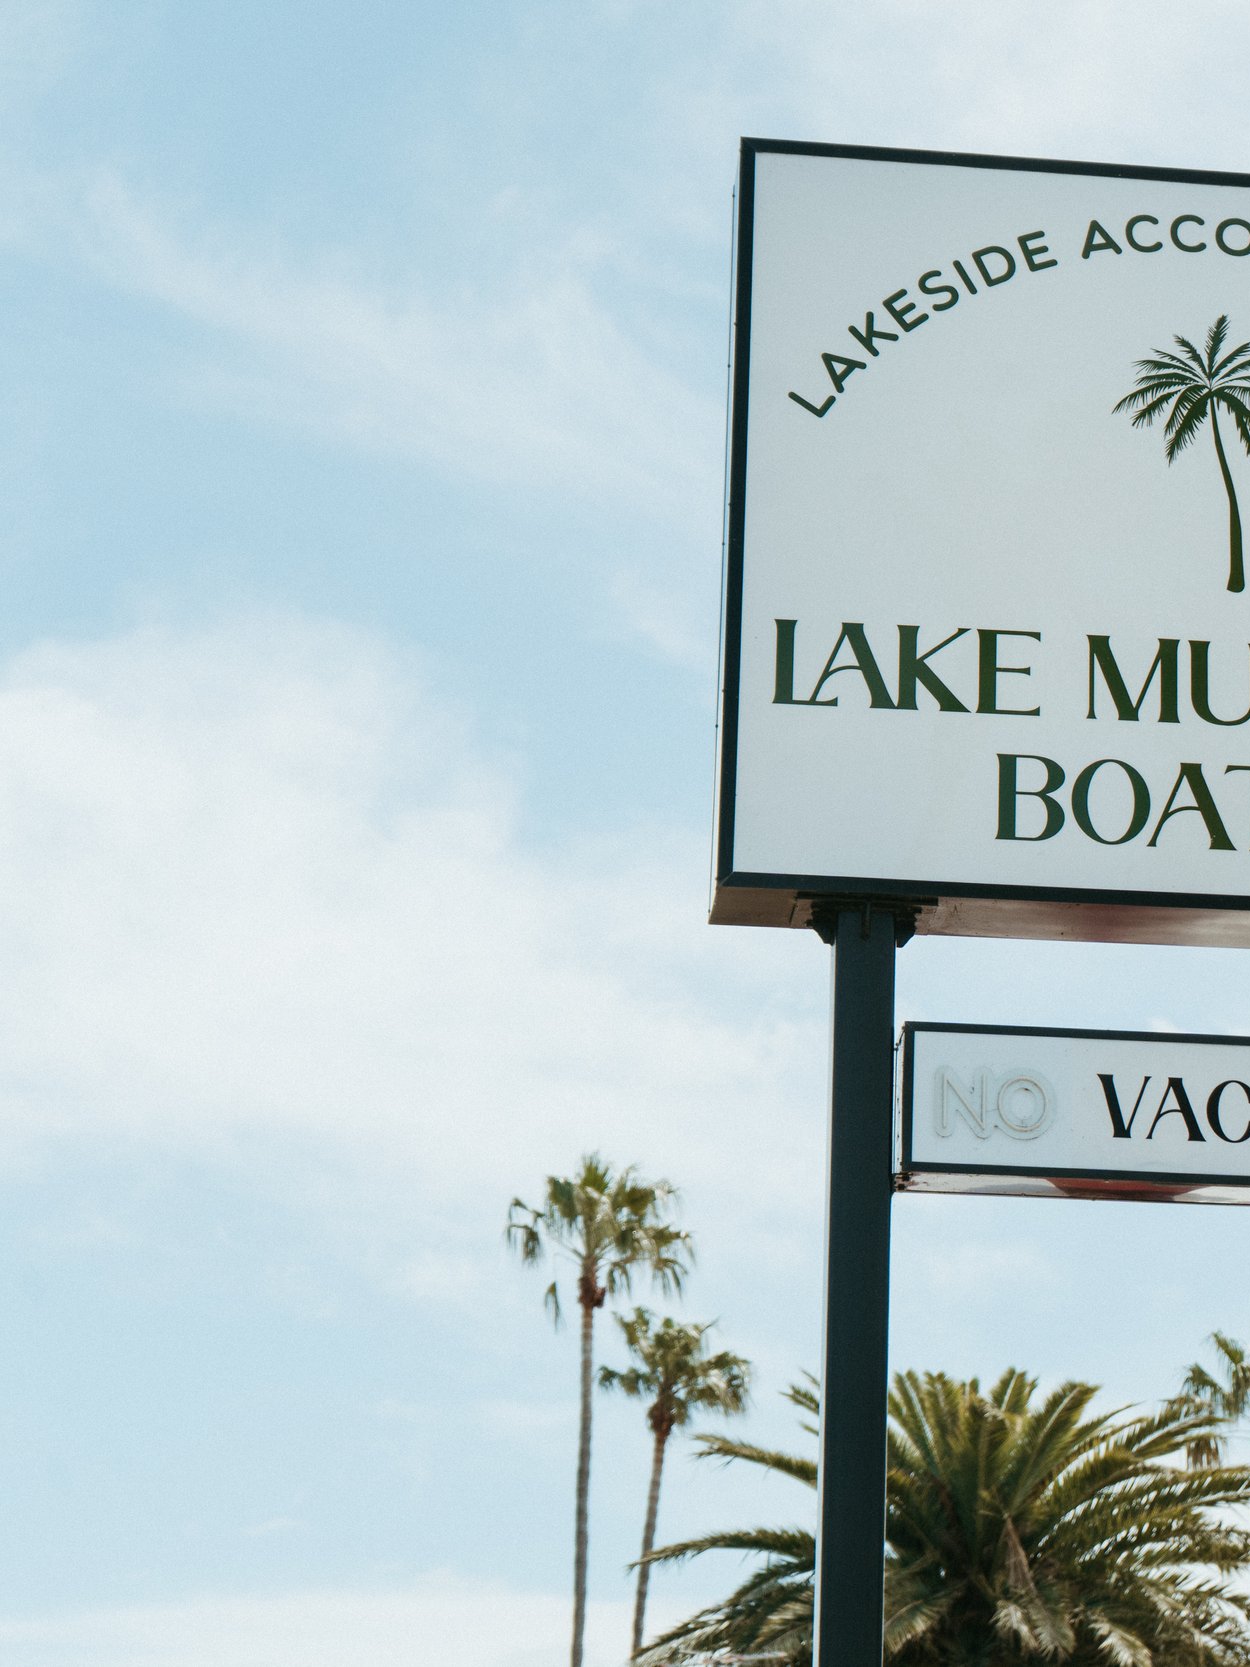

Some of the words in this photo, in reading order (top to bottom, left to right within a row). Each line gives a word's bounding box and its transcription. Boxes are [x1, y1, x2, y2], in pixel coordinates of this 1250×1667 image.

[787, 230, 1059, 419] LAKESIDE
[771, 618, 1042, 717] LAKE
[936, 1067, 1055, 1139] NO
